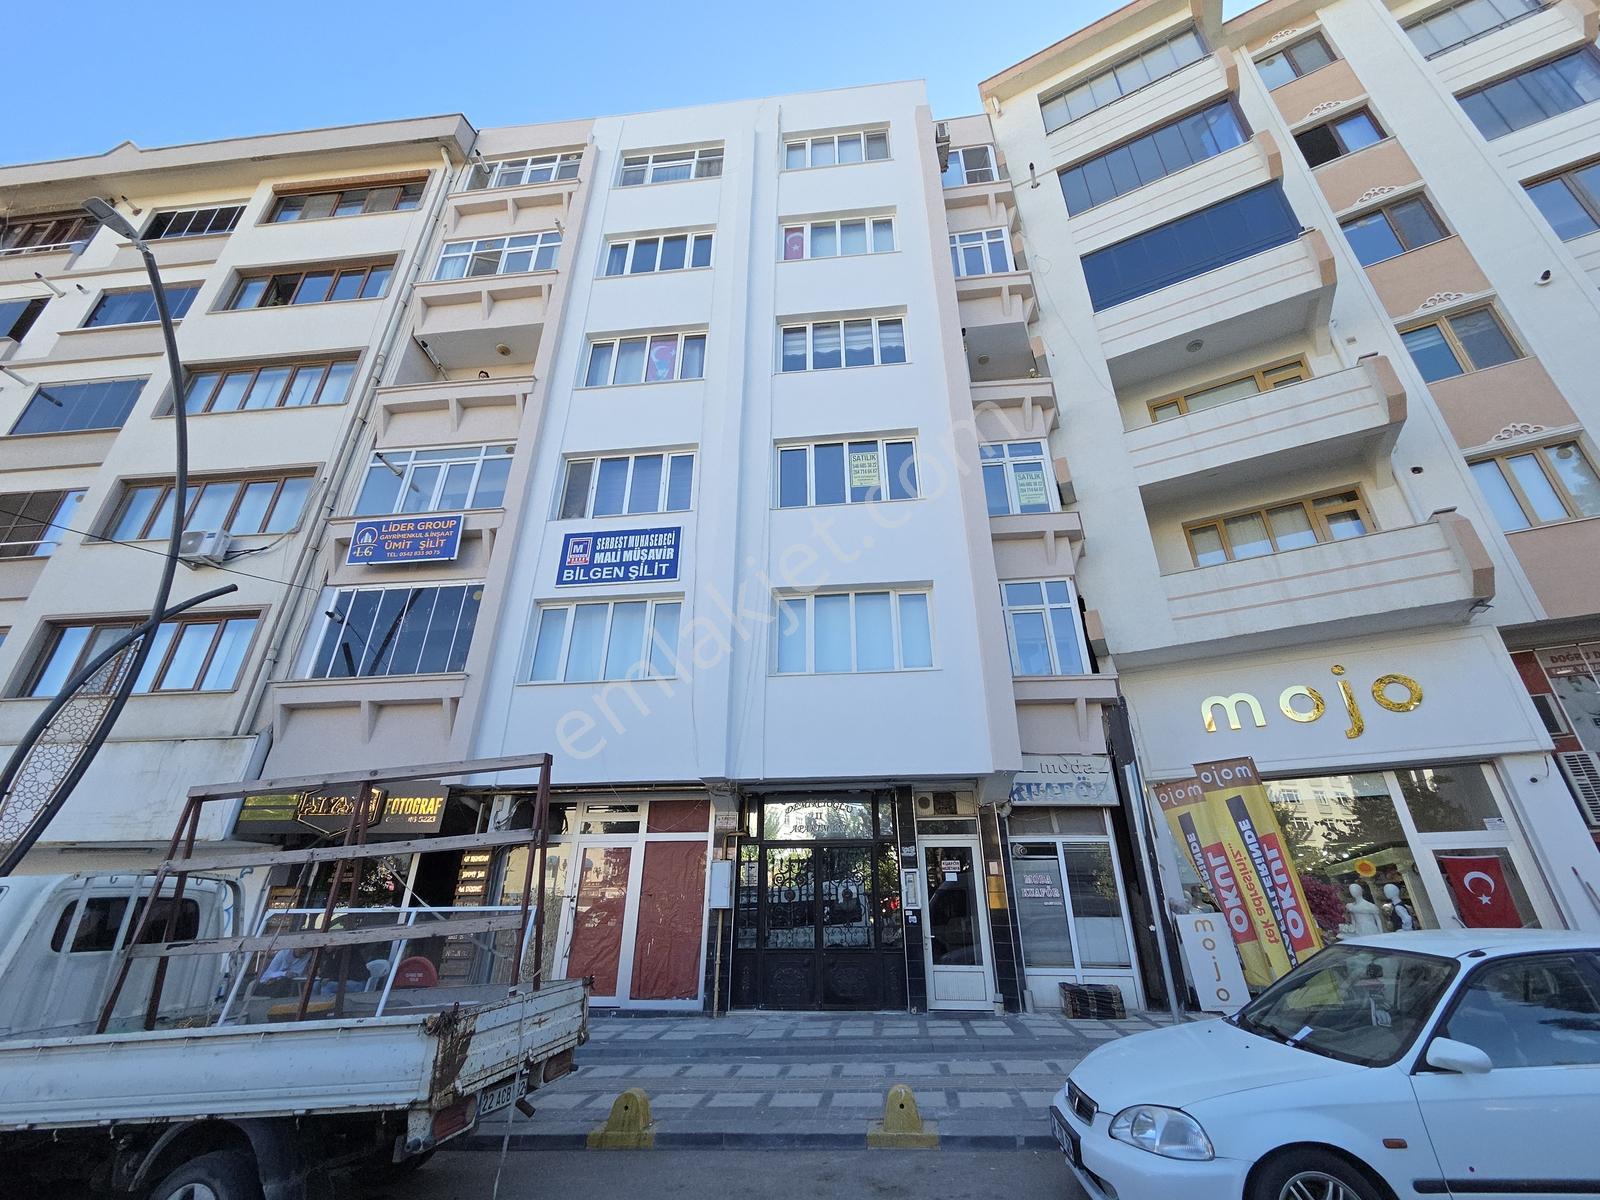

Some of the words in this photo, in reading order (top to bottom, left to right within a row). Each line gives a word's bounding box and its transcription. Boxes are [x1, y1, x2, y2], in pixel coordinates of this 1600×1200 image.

[381, 522, 414, 533] LİDER
[417, 519, 457, 530] GROUP
[385, 539, 413, 550] ÜMİT
[419, 537, 446, 551] ŞİLİT
[596, 535, 629, 551] SERBEST
[628, 530, 676, 549] MUHASEBECİ
[594, 549, 620, 564] MALİ
[622, 545, 675, 563] MÜŞAVİR
[562, 566, 625, 581] BİLGEN
[628, 562, 670, 580] ŞİLİT
[1201, 664, 1423, 739] mojo
[1040, 760, 1096, 774] moda
[385, 797, 444, 815] FOTOGRAF
[1194, 919, 1230, 1002] mojo
[482, 1093, 494, 1112] 22
[496, 1086, 511, 1107] ACB
